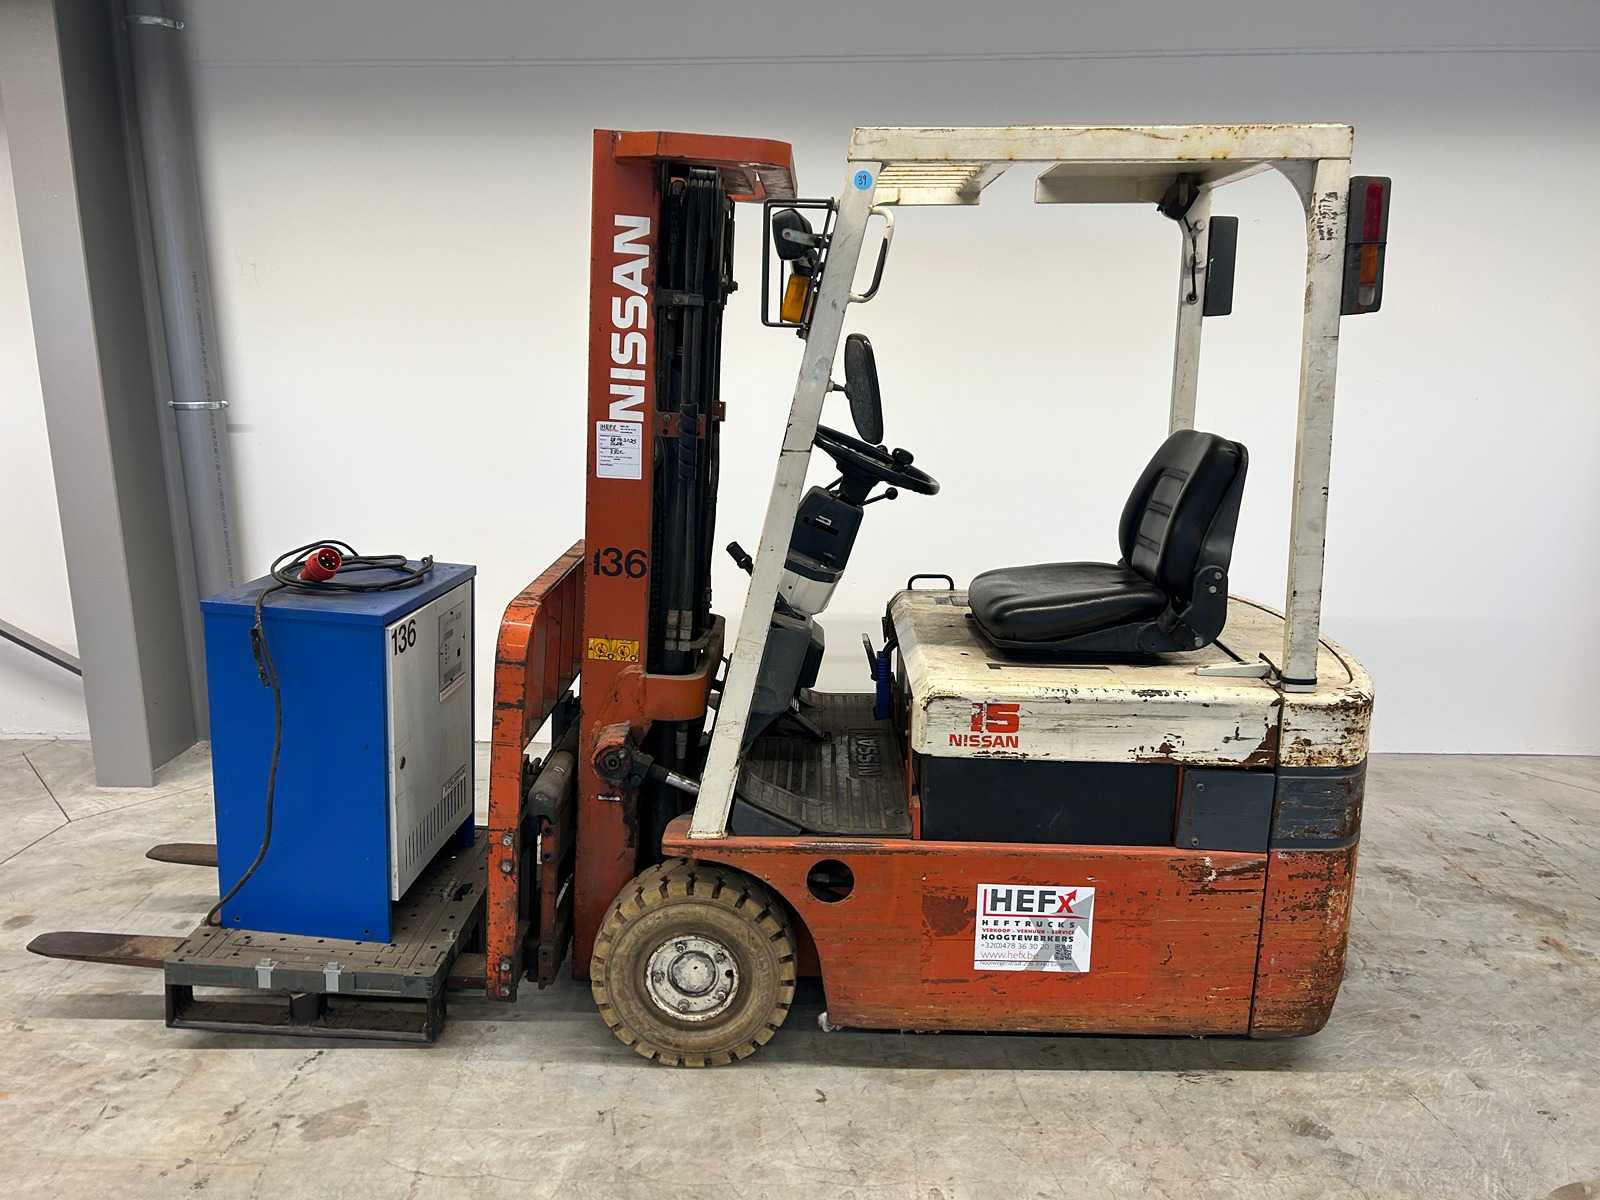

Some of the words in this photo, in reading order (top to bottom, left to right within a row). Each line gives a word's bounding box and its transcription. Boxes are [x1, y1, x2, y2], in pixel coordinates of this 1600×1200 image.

[858, 174, 867, 185] 39
[608, 214, 651, 422] NISSAN
[593, 547, 648, 579] 136
[391, 619, 417, 656] 136
[971, 702, 1020, 733] 15
[949, 734, 1019, 748] NISSAN
[982, 919, 1076, 929] HEFTRUCKS
[981, 934, 1075, 943] HOOGTEWERKERS
